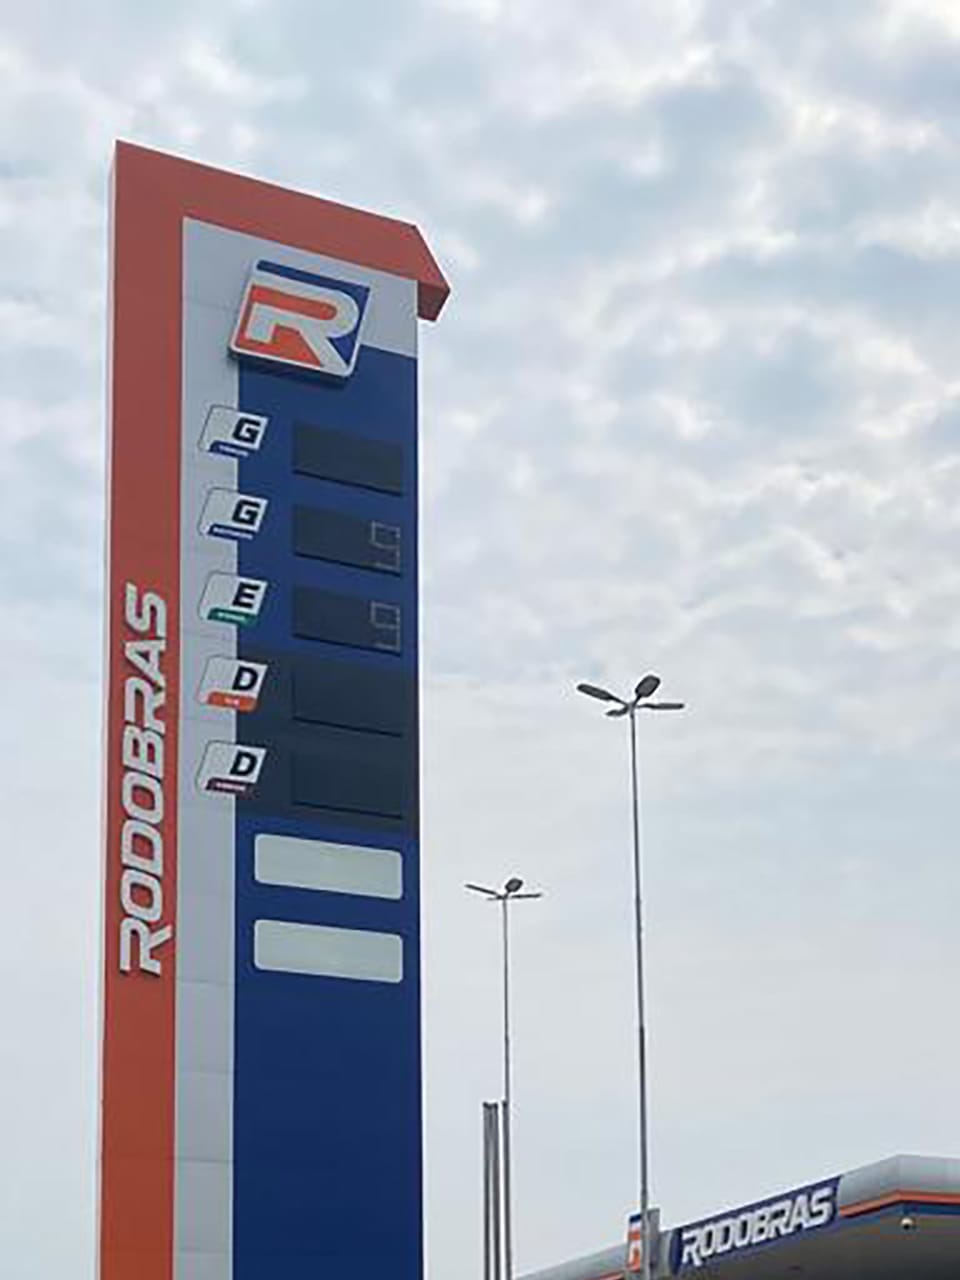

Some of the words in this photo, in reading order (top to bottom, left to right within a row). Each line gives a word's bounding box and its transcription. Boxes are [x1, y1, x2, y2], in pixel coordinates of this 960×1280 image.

[246, 268, 360, 375] R
[232, 417, 261, 444] G
[232, 499, 261, 526] G
[232, 582, 260, 608] E
[232, 666, 259, 690] D
[229, 750, 258, 776] D
[119, 583, 172, 976] RODOBRAS
[681, 1186, 833, 1267] RODOBRAS
